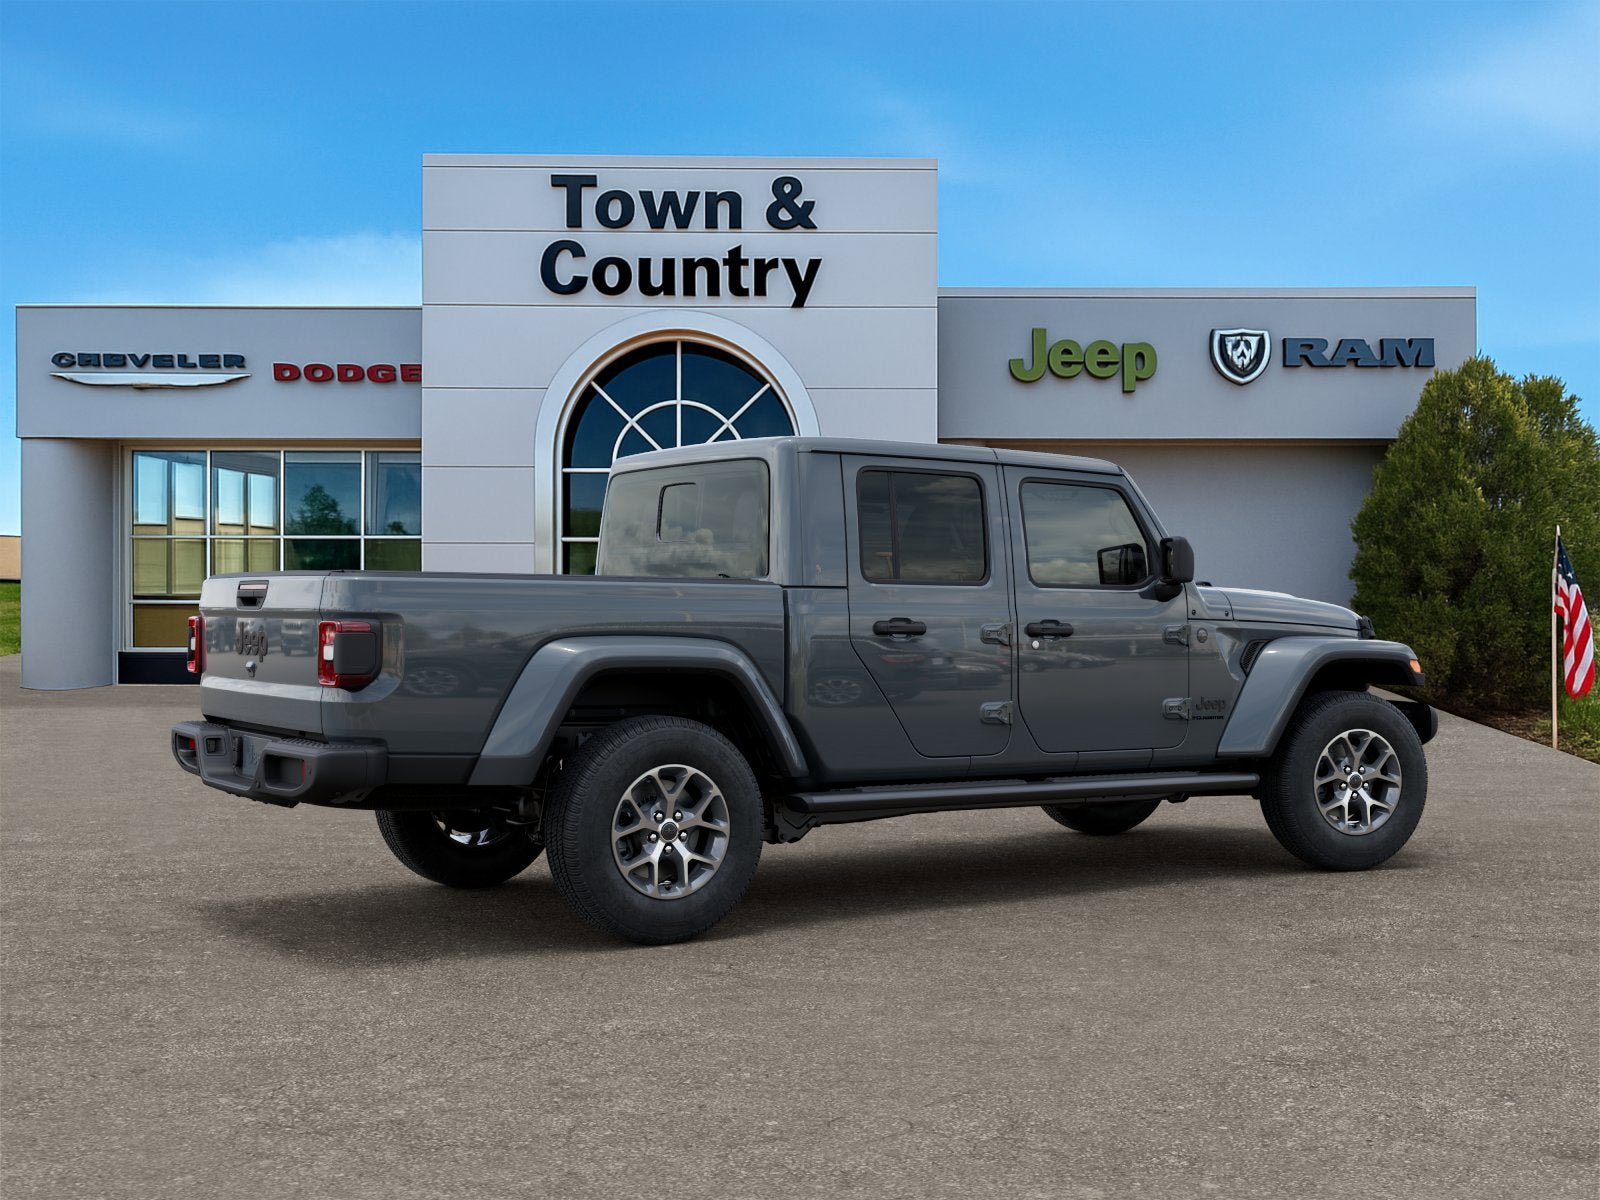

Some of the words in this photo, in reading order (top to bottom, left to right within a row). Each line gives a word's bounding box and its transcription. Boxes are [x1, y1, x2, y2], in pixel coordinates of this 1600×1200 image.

[550, 174, 743, 229] Town
[765, 175, 818, 230] &
[540, 239, 823, 308] Country
[273, 363, 422, 383] DODGE
[1009, 327, 1157, 393] Jeep
[1283, 337, 1436, 368] RAM
[235, 621, 269, 663] Jeep
[1195, 695, 1227, 713] Jeep
